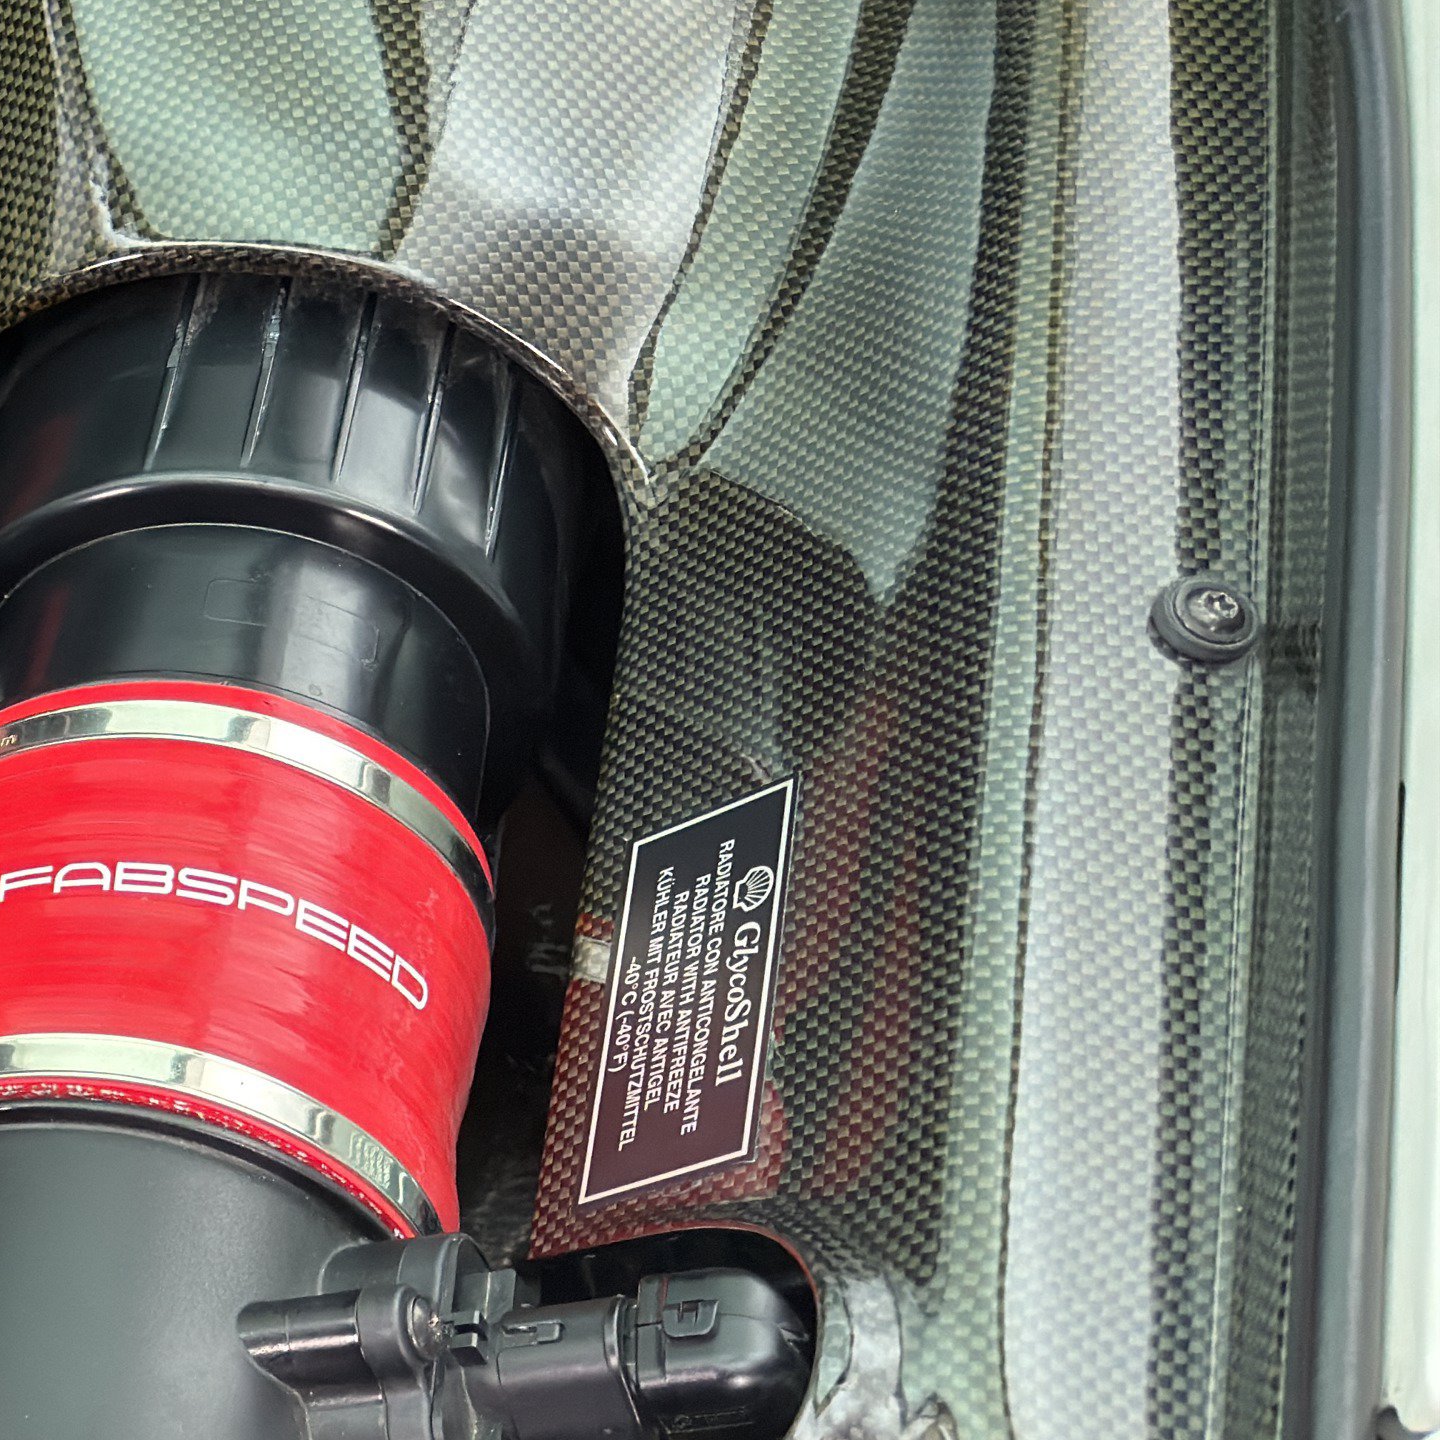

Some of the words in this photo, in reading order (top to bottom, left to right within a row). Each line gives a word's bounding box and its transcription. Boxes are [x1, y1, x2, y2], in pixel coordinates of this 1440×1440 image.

[651, 867, 675, 935] KÜHLER
[686, 874, 711, 959] RADIATOR
[708, 839, 735, 935] RADIATORE
[647, 936, 664, 963] MIT
[662, 891, 689, 986] RADIATEUR
[703, 938, 722, 975] CON
[621, 957, 641, 1006] -40°C
[656, 990, 675, 1033] AVEC
[679, 961, 699, 1006] WITH
[715, 921, 761, 1086] GlycoShell
[607, 1011, 634, 1073] (-40°F)
[618, 968, 659, 1151] FROSTSCHUTZMITTEL
[644, 1038, 668, 1111] ANTIGEL
[663, 1010, 692, 1113] ANTIFREEZE
[681, 980, 716, 1135] ANTICONGELANTE
